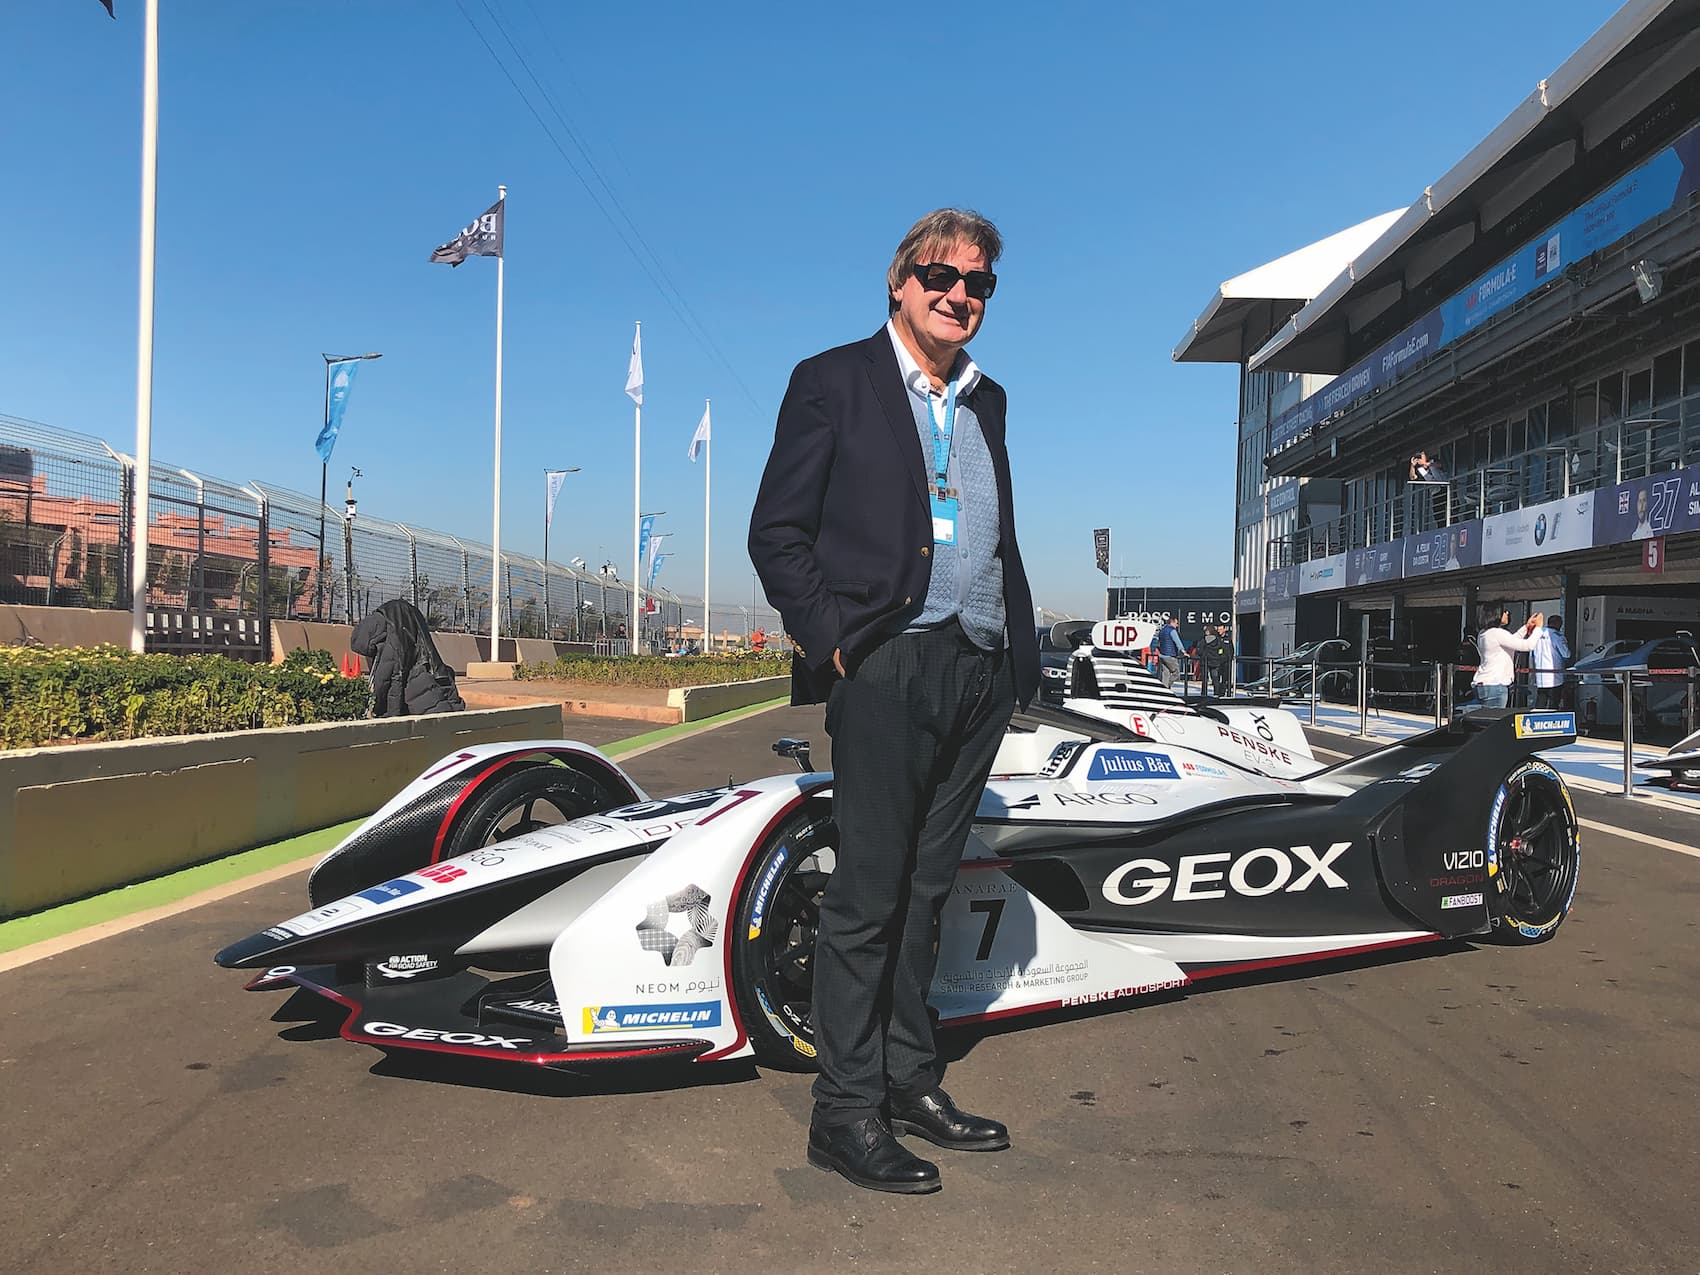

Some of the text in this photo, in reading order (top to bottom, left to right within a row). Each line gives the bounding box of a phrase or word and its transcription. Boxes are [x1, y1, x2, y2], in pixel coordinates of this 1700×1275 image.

[1651, 477, 1681, 531] 27
[1648, 540, 1658, 568] 5
[1103, 625, 1138, 647] LOP
[1534, 718, 1571, 731] MICHELIN
[1217, 726, 1293, 766] PENSKE
[1100, 756, 1172, 776] Julius Bär
[1054, 792, 1158, 807] ARGO
[1489, 790, 1506, 851] MICHELIN
[1443, 850, 1484, 870] VIZIO
[754, 851, 787, 915] MICHELIN
[1101, 843, 1351, 906] GEOX
[1429, 874, 1484, 888] DRAGON
[1449, 893, 1482, 907] FANBOOST
[969, 899, 1006, 960] 7
[398, 961, 415, 969] ROAD
[415, 959, 438, 969] SAFETY
[400, 954, 428, 963] ACTION
[636, 983, 680, 994] NEOM
[969, 979, 1014, 991] RESEARCH
[1015, 979, 1021, 989] &
[1023, 976, 1065, 988] MARKETING
[1066, 973, 1089, 984] GROUP
[622, 1010, 712, 1025] MICHELIN
[363, 1021, 533, 1049] GEOX
